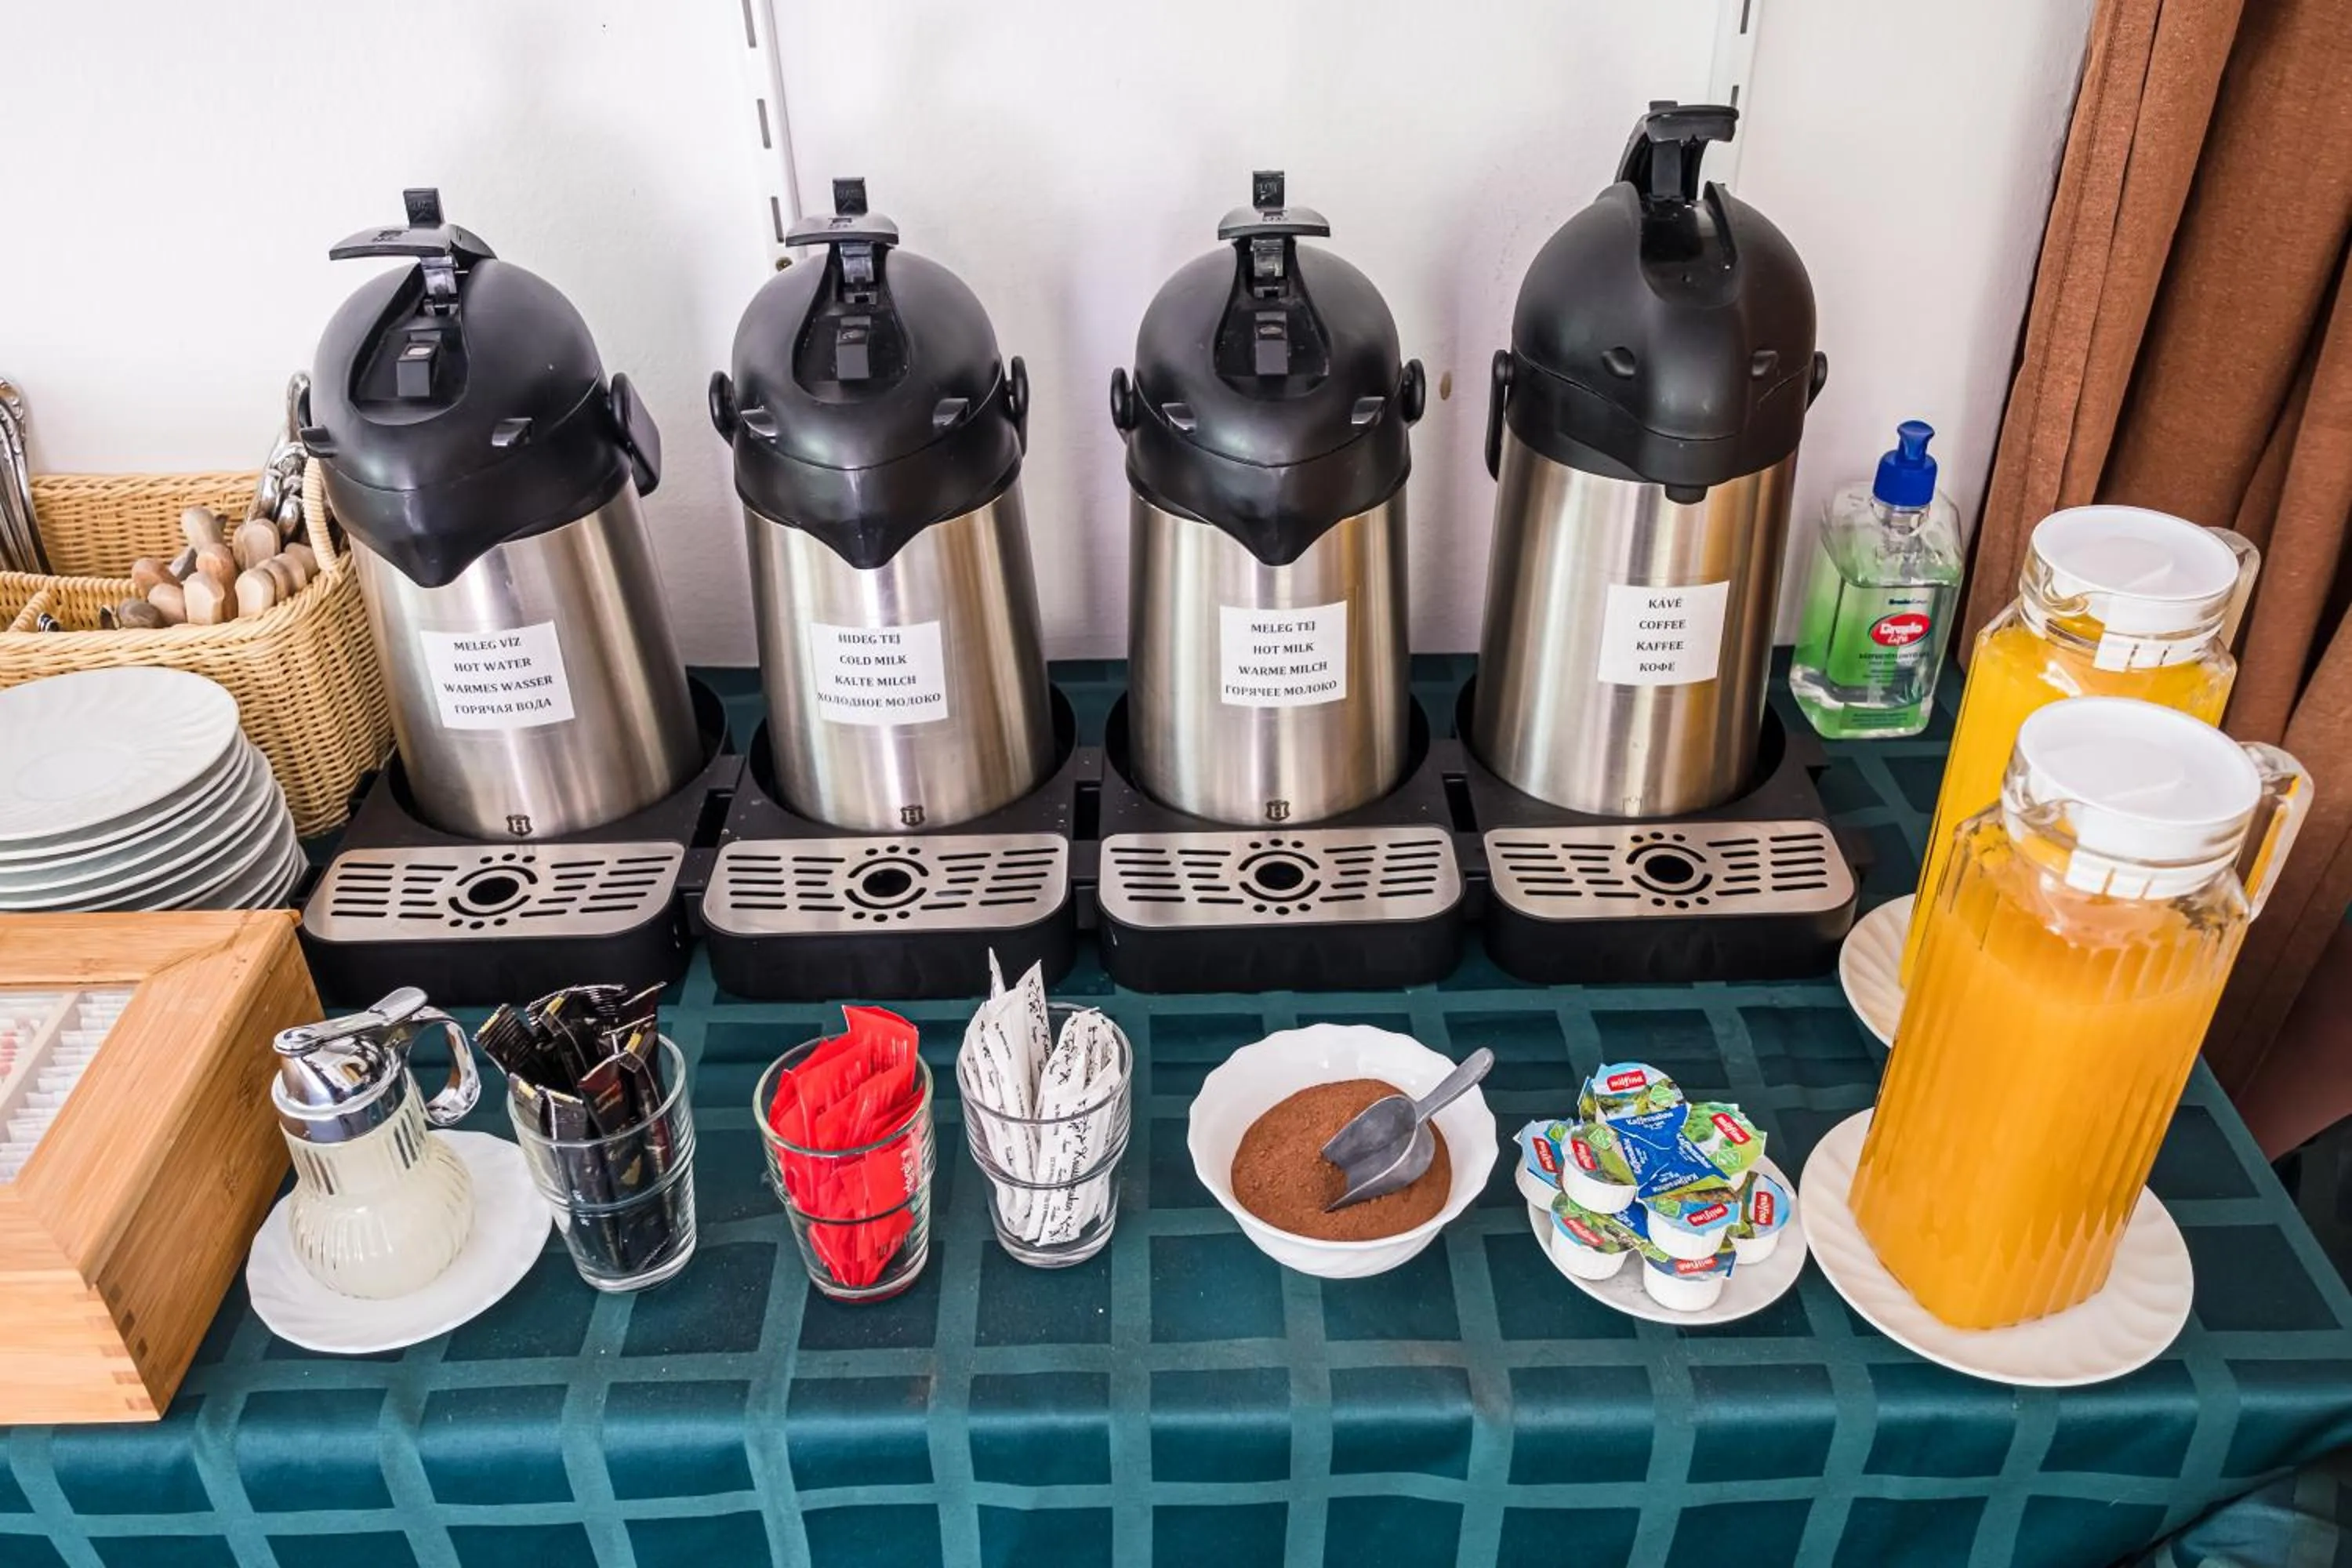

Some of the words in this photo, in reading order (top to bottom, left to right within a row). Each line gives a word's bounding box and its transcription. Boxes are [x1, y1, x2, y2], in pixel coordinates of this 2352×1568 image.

[1250, 623, 1293, 633] MELEG
[1639, 619, 1686, 630] COFFEE
[838, 633, 877, 644] HIDEG
[453, 641, 497, 652] MELEG
[1254, 644, 1280, 655] HOT
[1282, 642, 1315, 654] MILK
[1636, 641, 1685, 652] KAFFEE
[454, 662, 481, 672] HOT
[483, 657, 532, 671] WATER
[840, 654, 872, 666] COLD
[874, 654, 909, 666] MILK
[1238, 665, 1287, 675] WARME
[1290, 661, 1328, 675] MILCH
[1639, 662, 1675, 672] КОФЕ
[443, 683, 498, 694] WARMES
[500, 675, 554, 691] WASSER
[835, 674, 874, 687] KALTE
[877, 675, 916, 687] MILCH
[1225, 684, 1282, 697] ГОРЯЧЕЕ
[1283, 680, 1338, 695] МОЛОКО
[817, 691, 883, 708] ХОЛОДНОЕ
[885, 692, 942, 706] МОЛОКО
[454, 704, 513, 715] ГОРЯЧАЯ
[516, 698, 552, 712] ВОДА
